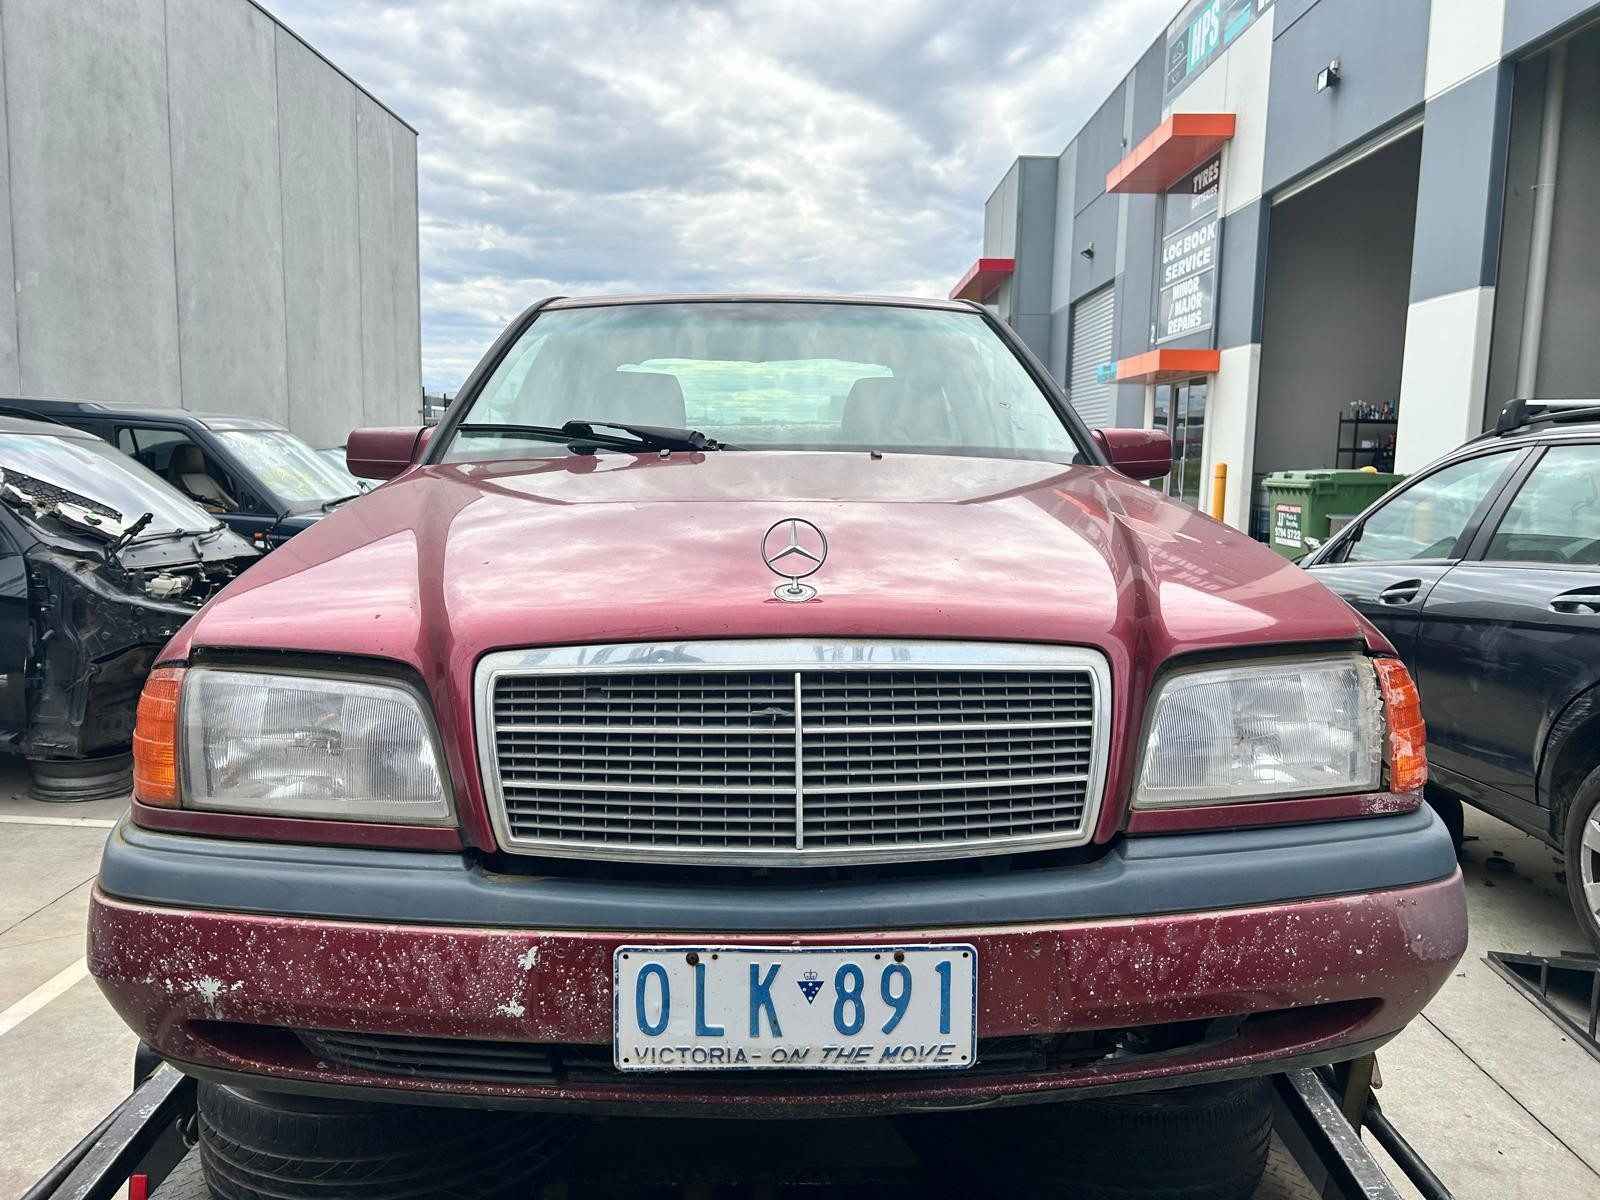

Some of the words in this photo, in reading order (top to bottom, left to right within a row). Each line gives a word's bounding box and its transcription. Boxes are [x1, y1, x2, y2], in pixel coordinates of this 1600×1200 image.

[1193, 160, 1219, 192] TYRES
[1165, 246, 1211, 282] SERVICE
[1172, 275, 1200, 301] MINOR
[1167, 310, 1202, 335] REPAIRS
[635, 962, 783, 1038] OLK
[833, 960, 952, 1036] 891
[771, 1046, 810, 1064] ON
[820, 1046, 874, 1064] THE
[881, 1044, 957, 1064] MOVE
